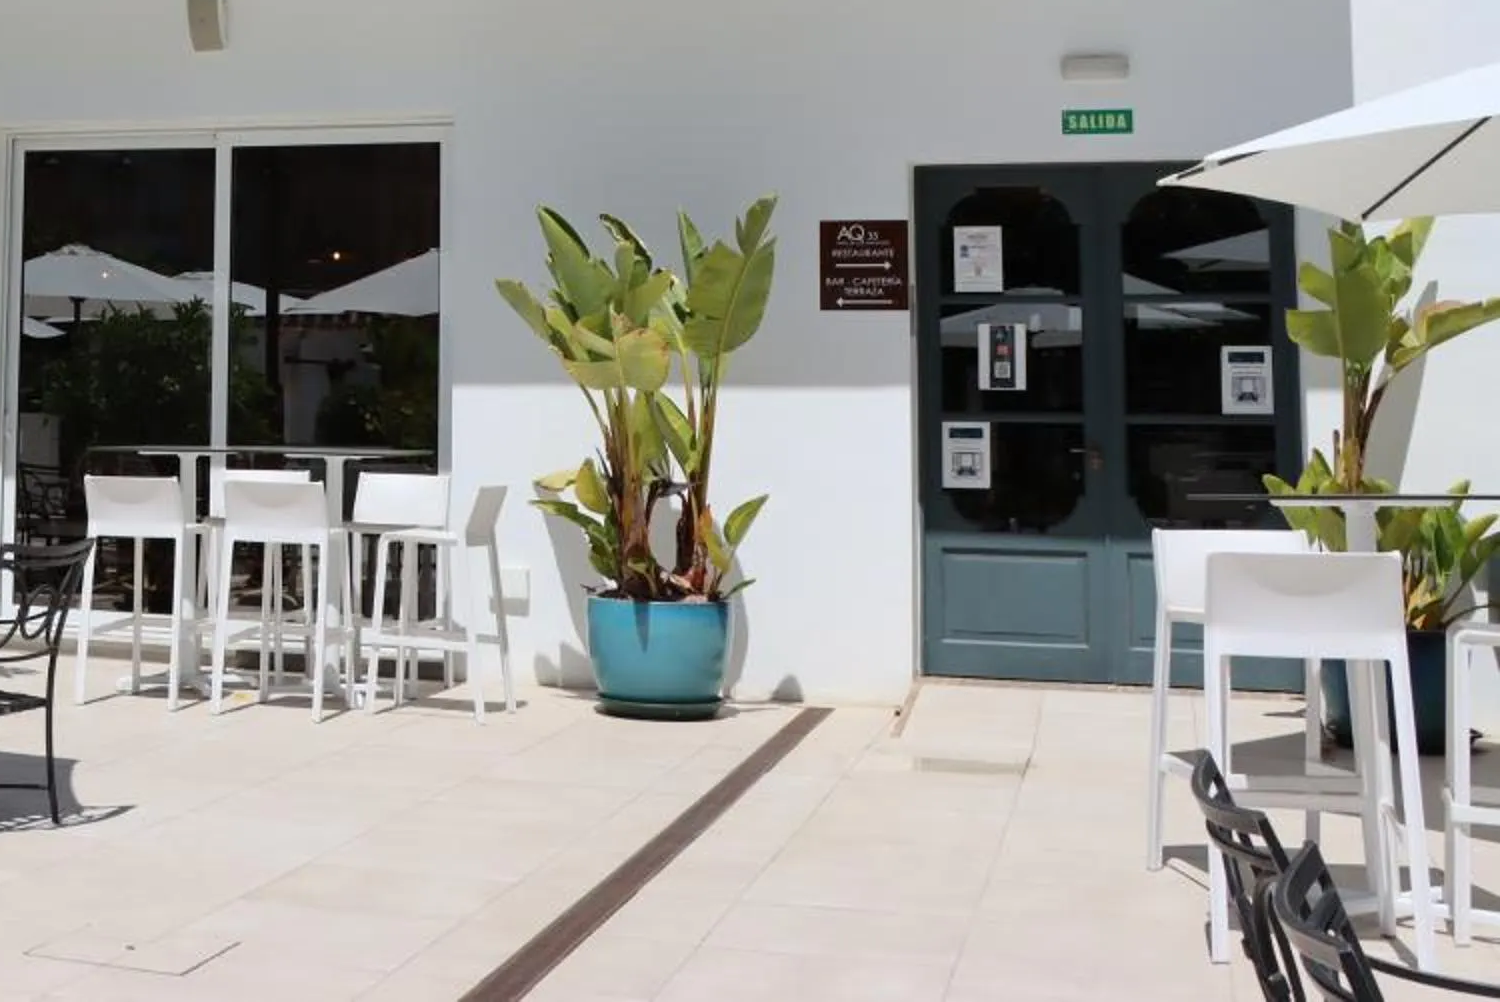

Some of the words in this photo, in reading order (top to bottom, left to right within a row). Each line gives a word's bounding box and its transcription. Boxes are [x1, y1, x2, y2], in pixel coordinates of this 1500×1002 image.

[1067, 112, 1127, 130] SALIDA
[837, 223, 865, 244] AQ
[830, 247, 895, 258] RESTAURANTE
[825, 277, 845, 287] BAR
[843, 286, 885, 296] TERRAZA
